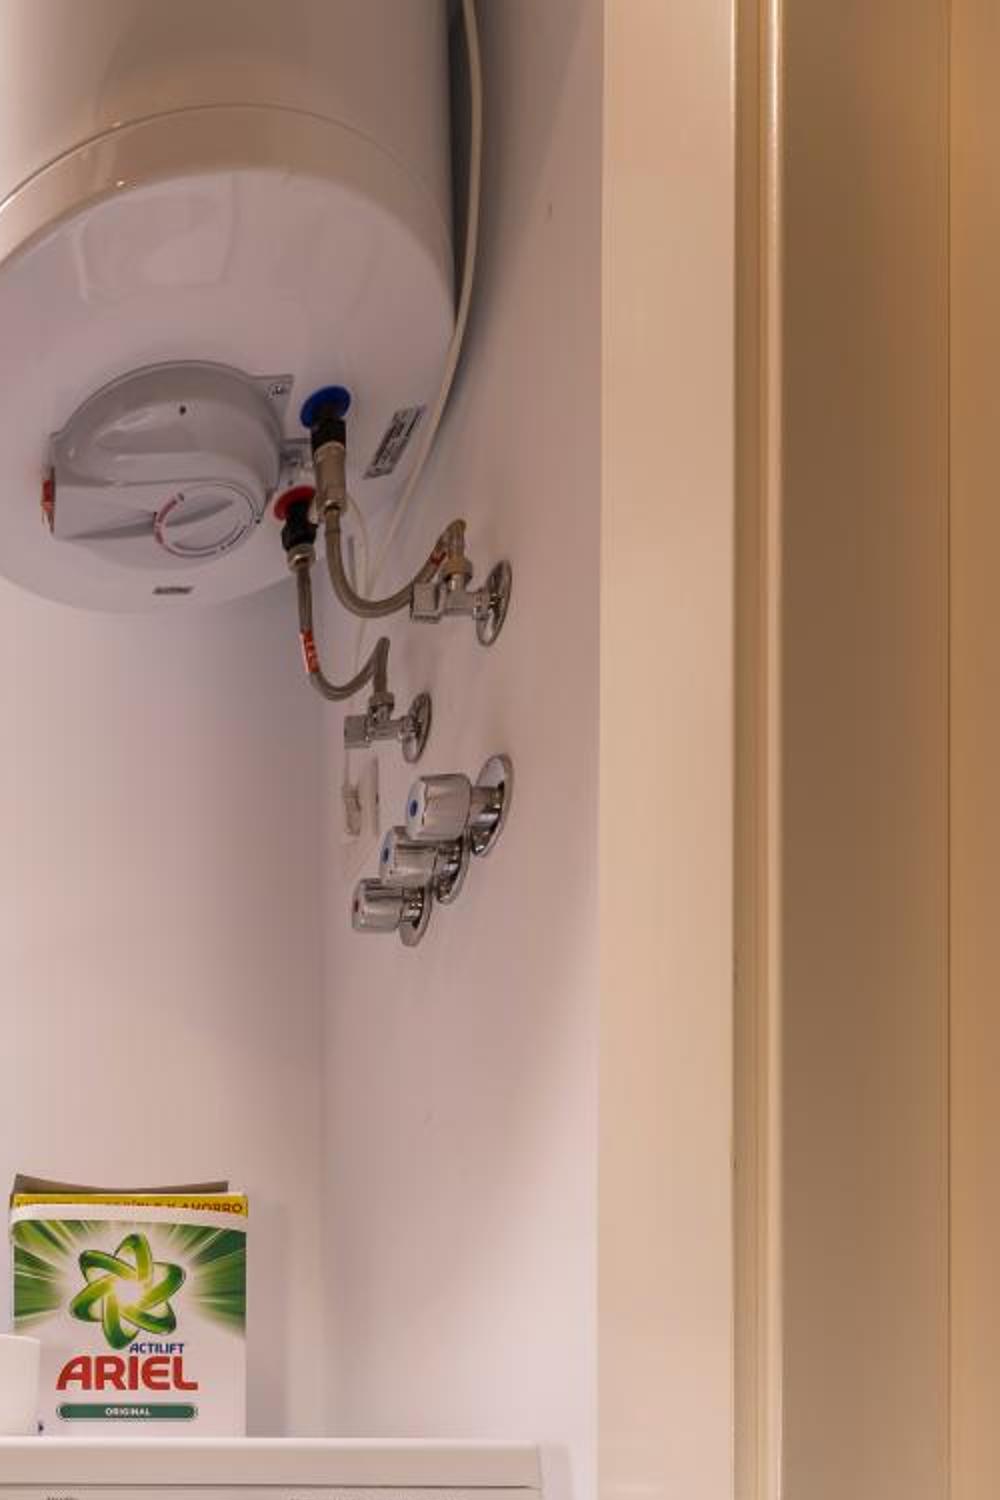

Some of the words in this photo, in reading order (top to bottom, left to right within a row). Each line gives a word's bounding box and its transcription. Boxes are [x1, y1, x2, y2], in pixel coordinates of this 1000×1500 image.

[129, 1343, 185, 1354] ACTILIFT
[56, 1355, 198, 1390] ARIEL
[104, 1407, 151, 1417] ORIGINAL
